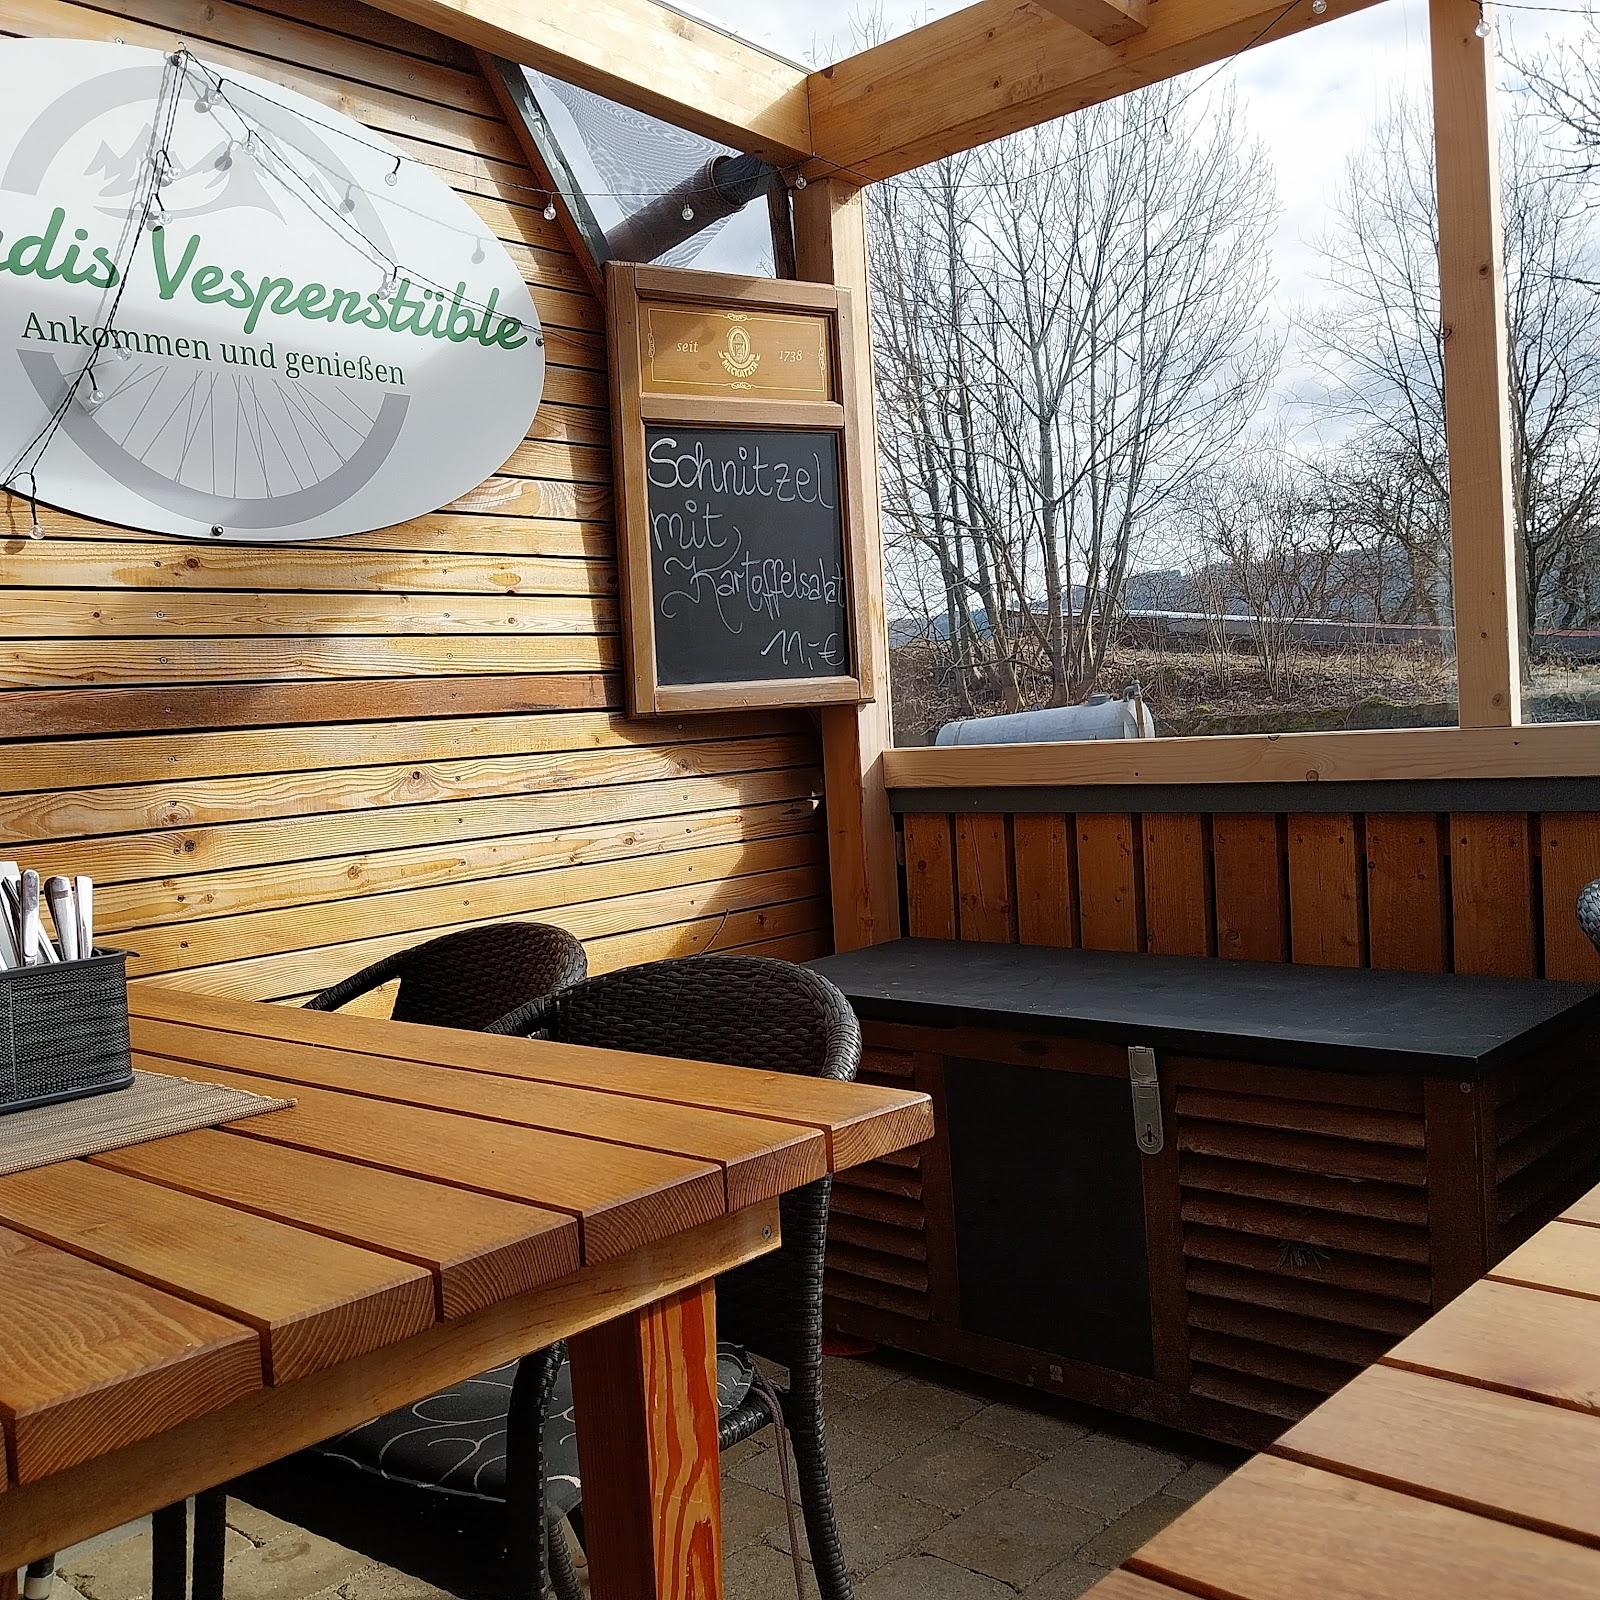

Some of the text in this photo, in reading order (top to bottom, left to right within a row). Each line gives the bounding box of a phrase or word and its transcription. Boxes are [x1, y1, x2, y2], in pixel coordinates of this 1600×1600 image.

[0, 207, 528, 350] dis Vesperstüble
[21, 311, 406, 386] Ankommen und genießen
[676, 340, 803, 362] seit 1738
[721, 359, 759, 378] MECKATZER
[648, 437, 834, 510] Schnitzel
[650, 500, 728, 551] mit
[661, 526, 845, 634] Kartoffelsalat
